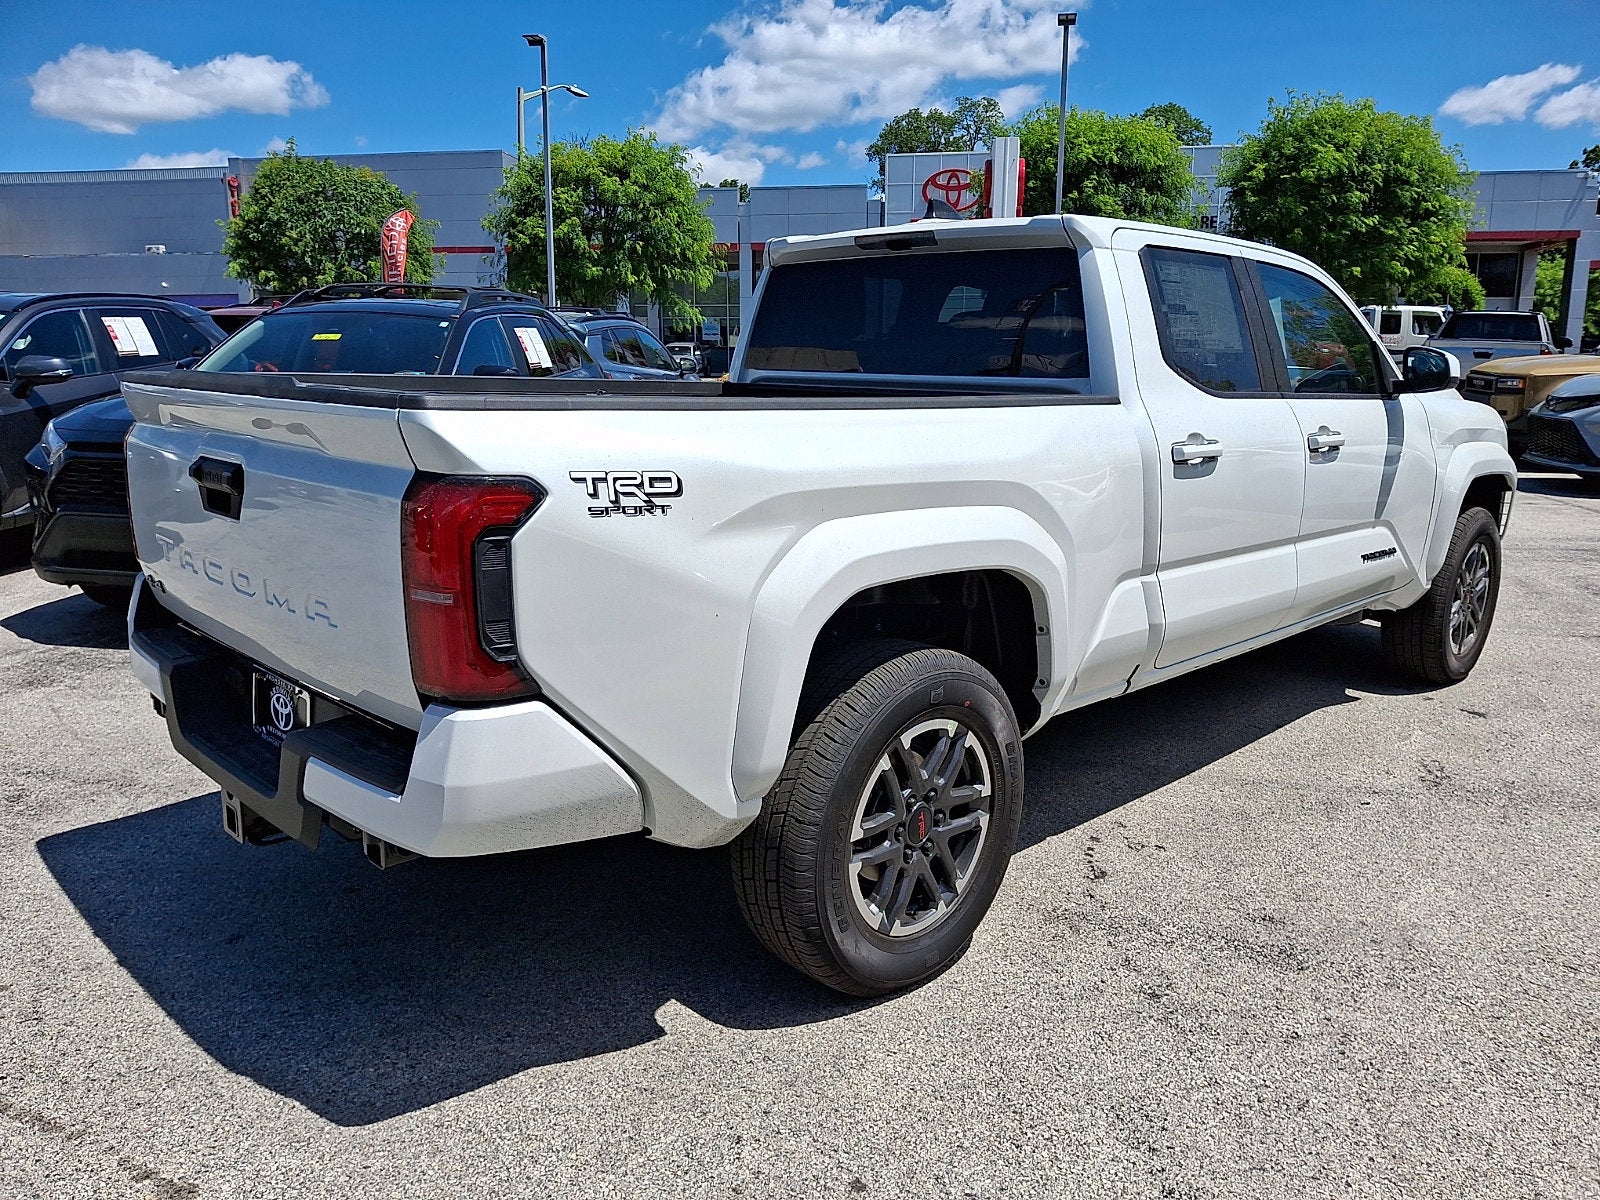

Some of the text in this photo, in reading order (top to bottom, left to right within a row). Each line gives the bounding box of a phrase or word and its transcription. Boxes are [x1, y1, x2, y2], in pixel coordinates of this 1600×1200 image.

[569, 470, 684, 506] TRD
[587, 504, 672, 518] SPORT
[156, 533, 338, 628] TACOMA
